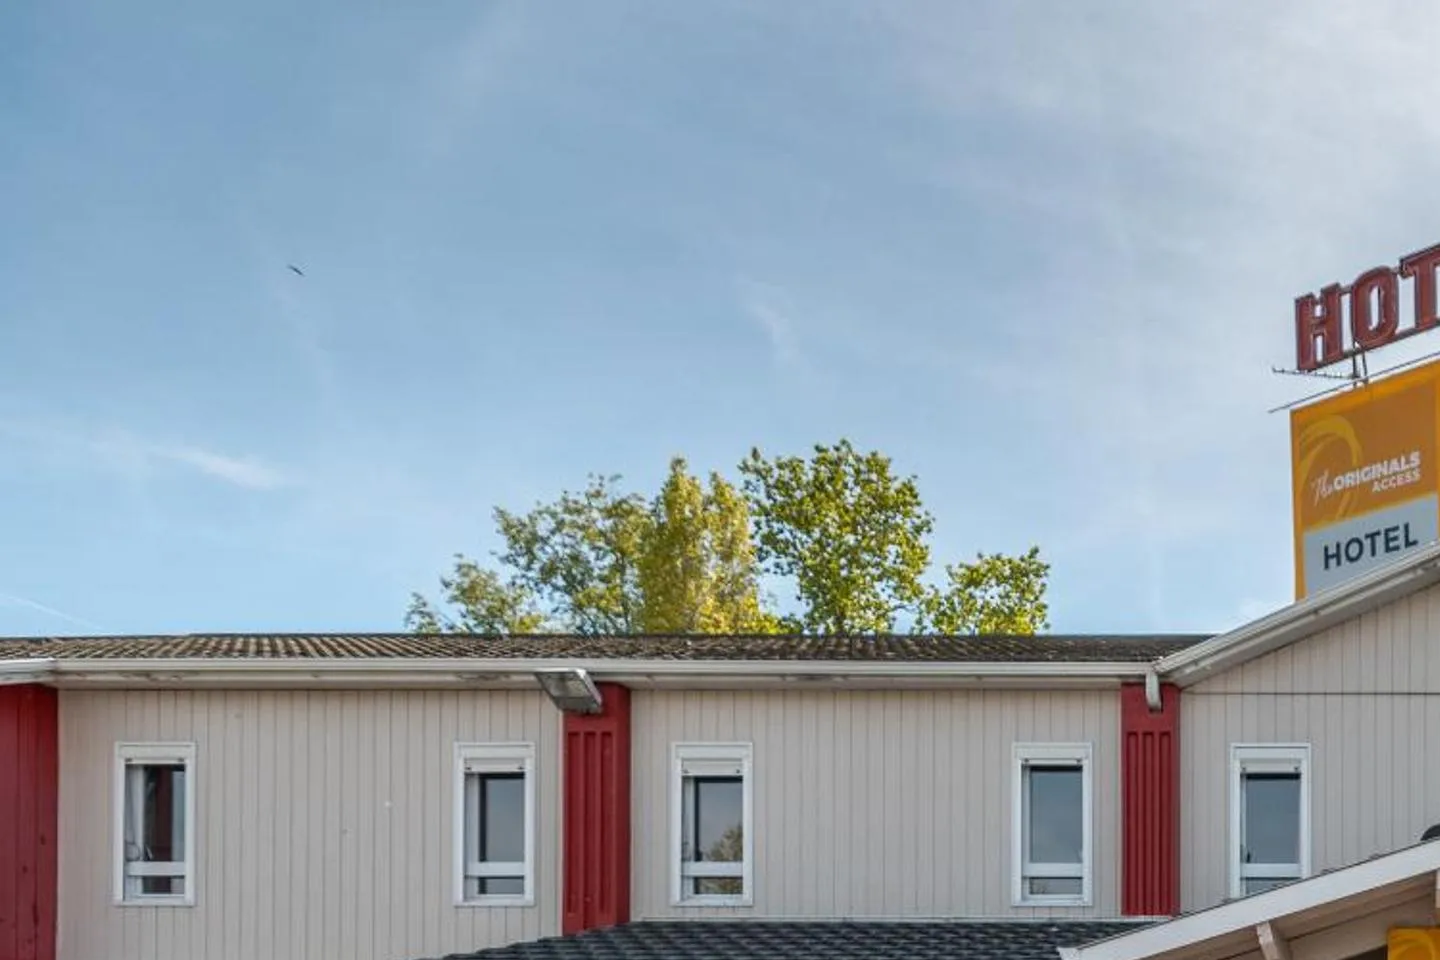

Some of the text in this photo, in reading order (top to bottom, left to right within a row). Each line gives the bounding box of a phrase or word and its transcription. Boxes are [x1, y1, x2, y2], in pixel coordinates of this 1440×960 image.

[1333, 450, 1421, 491] ORIGINALS
[1371, 467, 1421, 493] ACCESS
[1323, 521, 1419, 570] HOTEL
